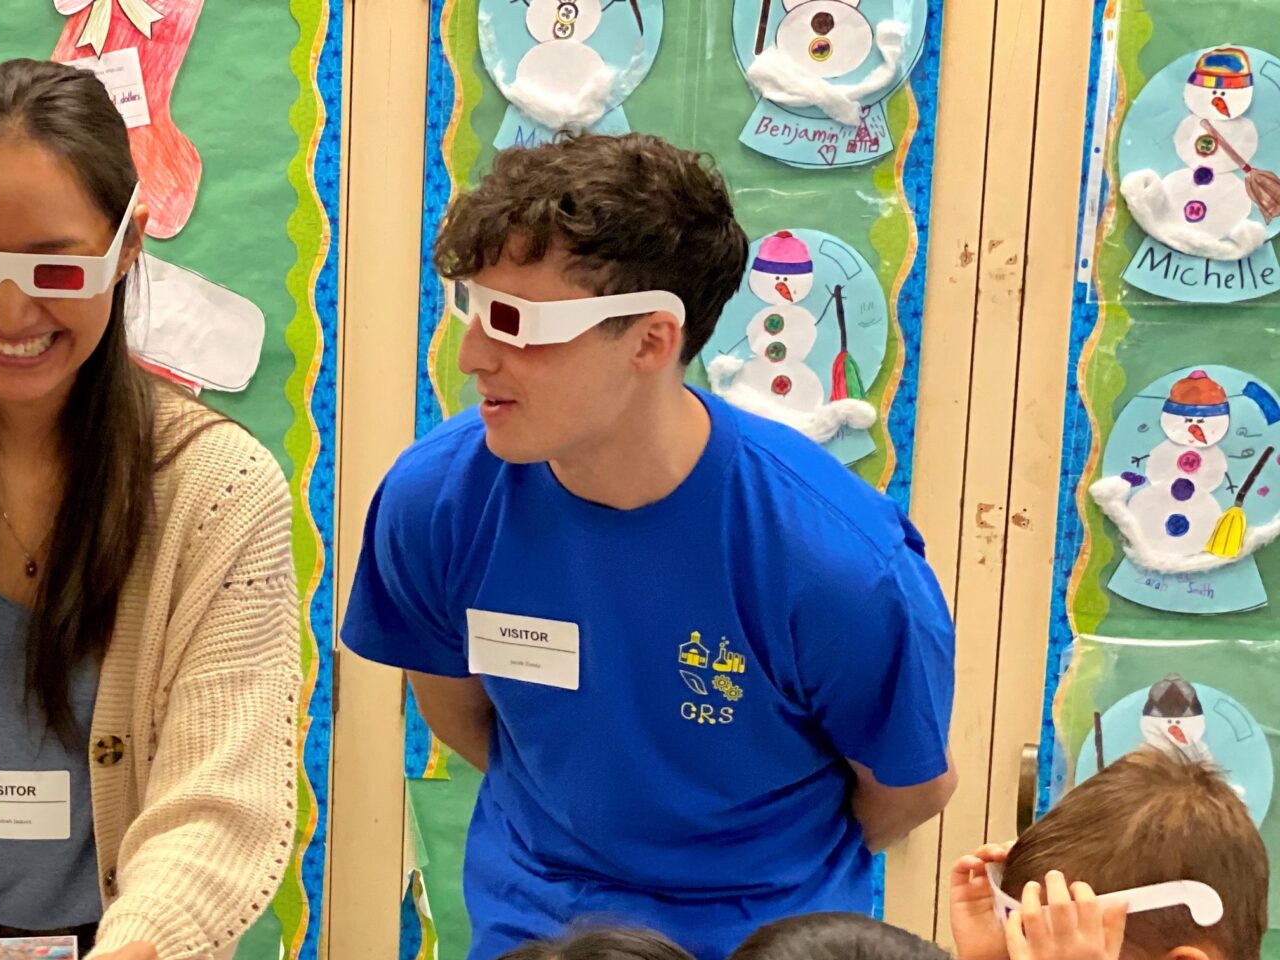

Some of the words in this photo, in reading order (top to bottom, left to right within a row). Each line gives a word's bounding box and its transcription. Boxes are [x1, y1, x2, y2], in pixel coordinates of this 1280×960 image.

[755, 116, 838, 145] Benjamin
[1137, 247, 1274, 290] Michelle
[499, 627, 549, 642] VISITOR
[681, 702, 734, 725] CRS
